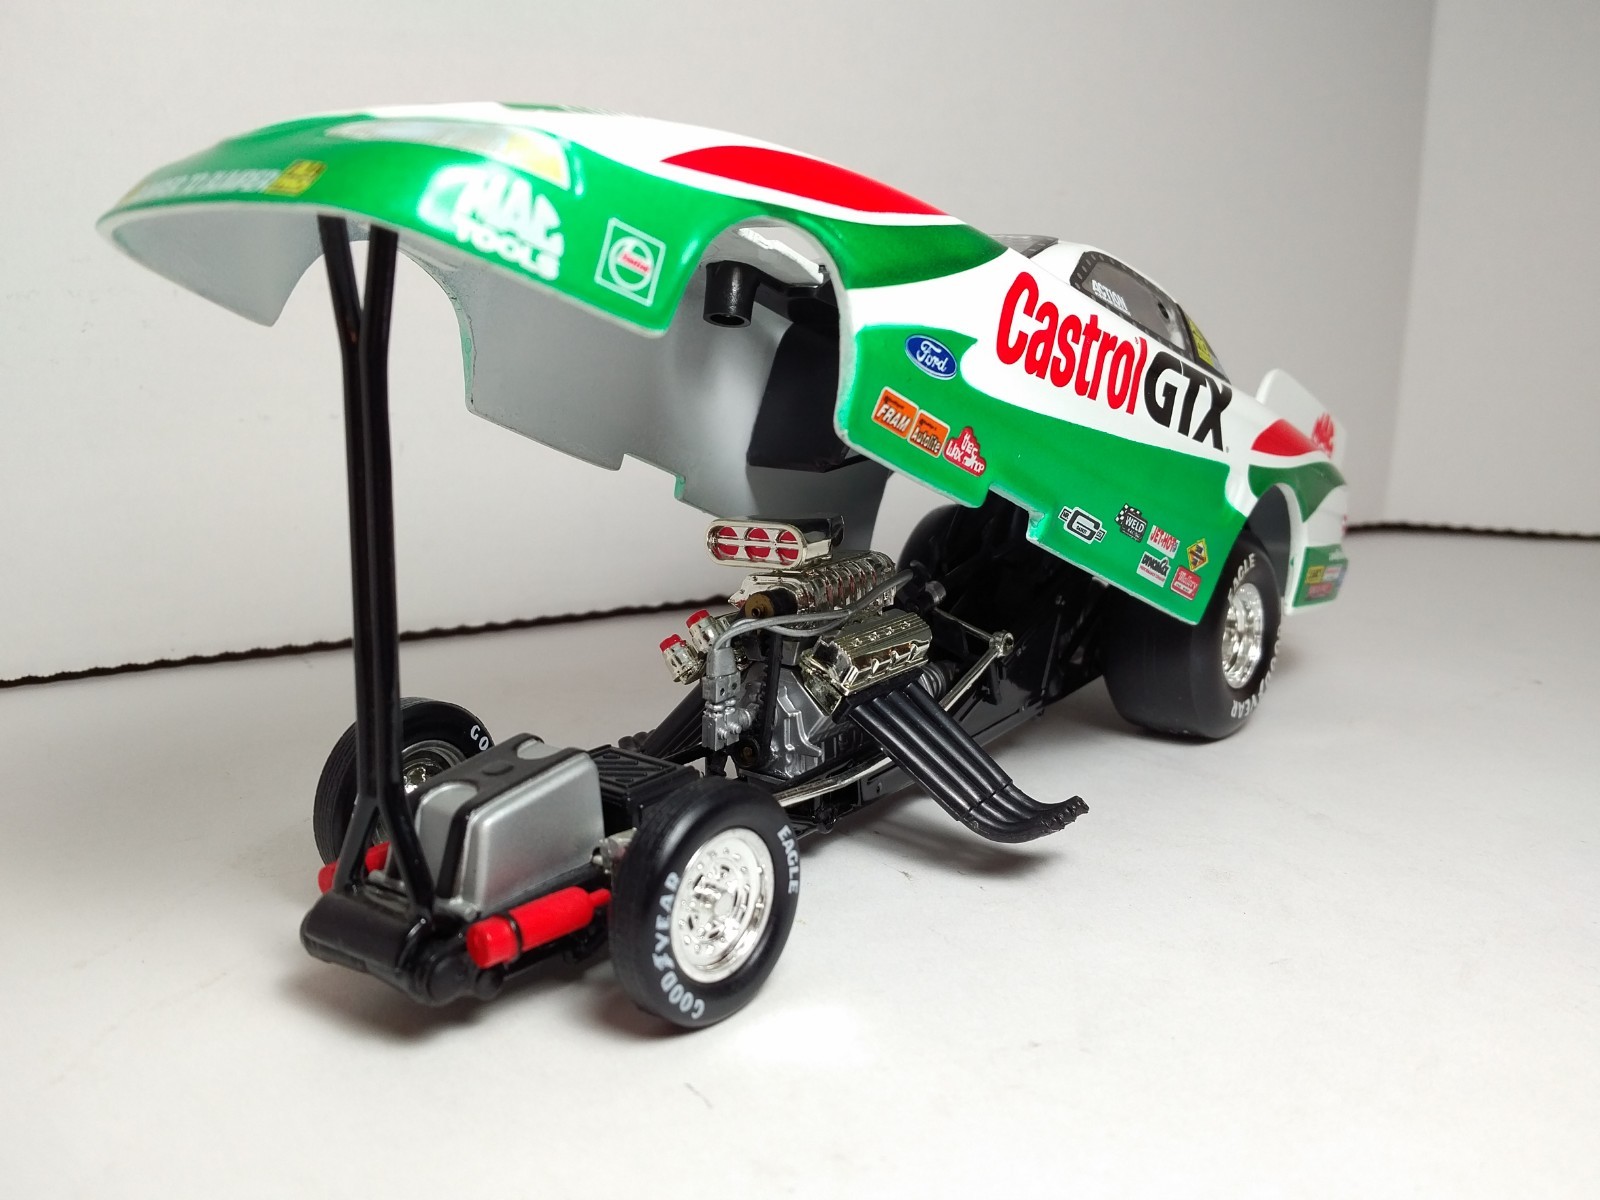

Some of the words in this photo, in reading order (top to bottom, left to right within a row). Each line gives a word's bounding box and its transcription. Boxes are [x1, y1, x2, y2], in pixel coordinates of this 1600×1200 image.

[456, 218, 561, 281] TOOLS
[916, 340, 949, 373] Ford
[996, 271, 1148, 416] Castrol
[1144, 351, 1232, 452] GTX
[876, 403, 911, 432] FRAM
[910, 426, 942, 454] Autolite
[1125, 515, 1145, 534] WELD
[777, 824, 800, 895] EAGLE
